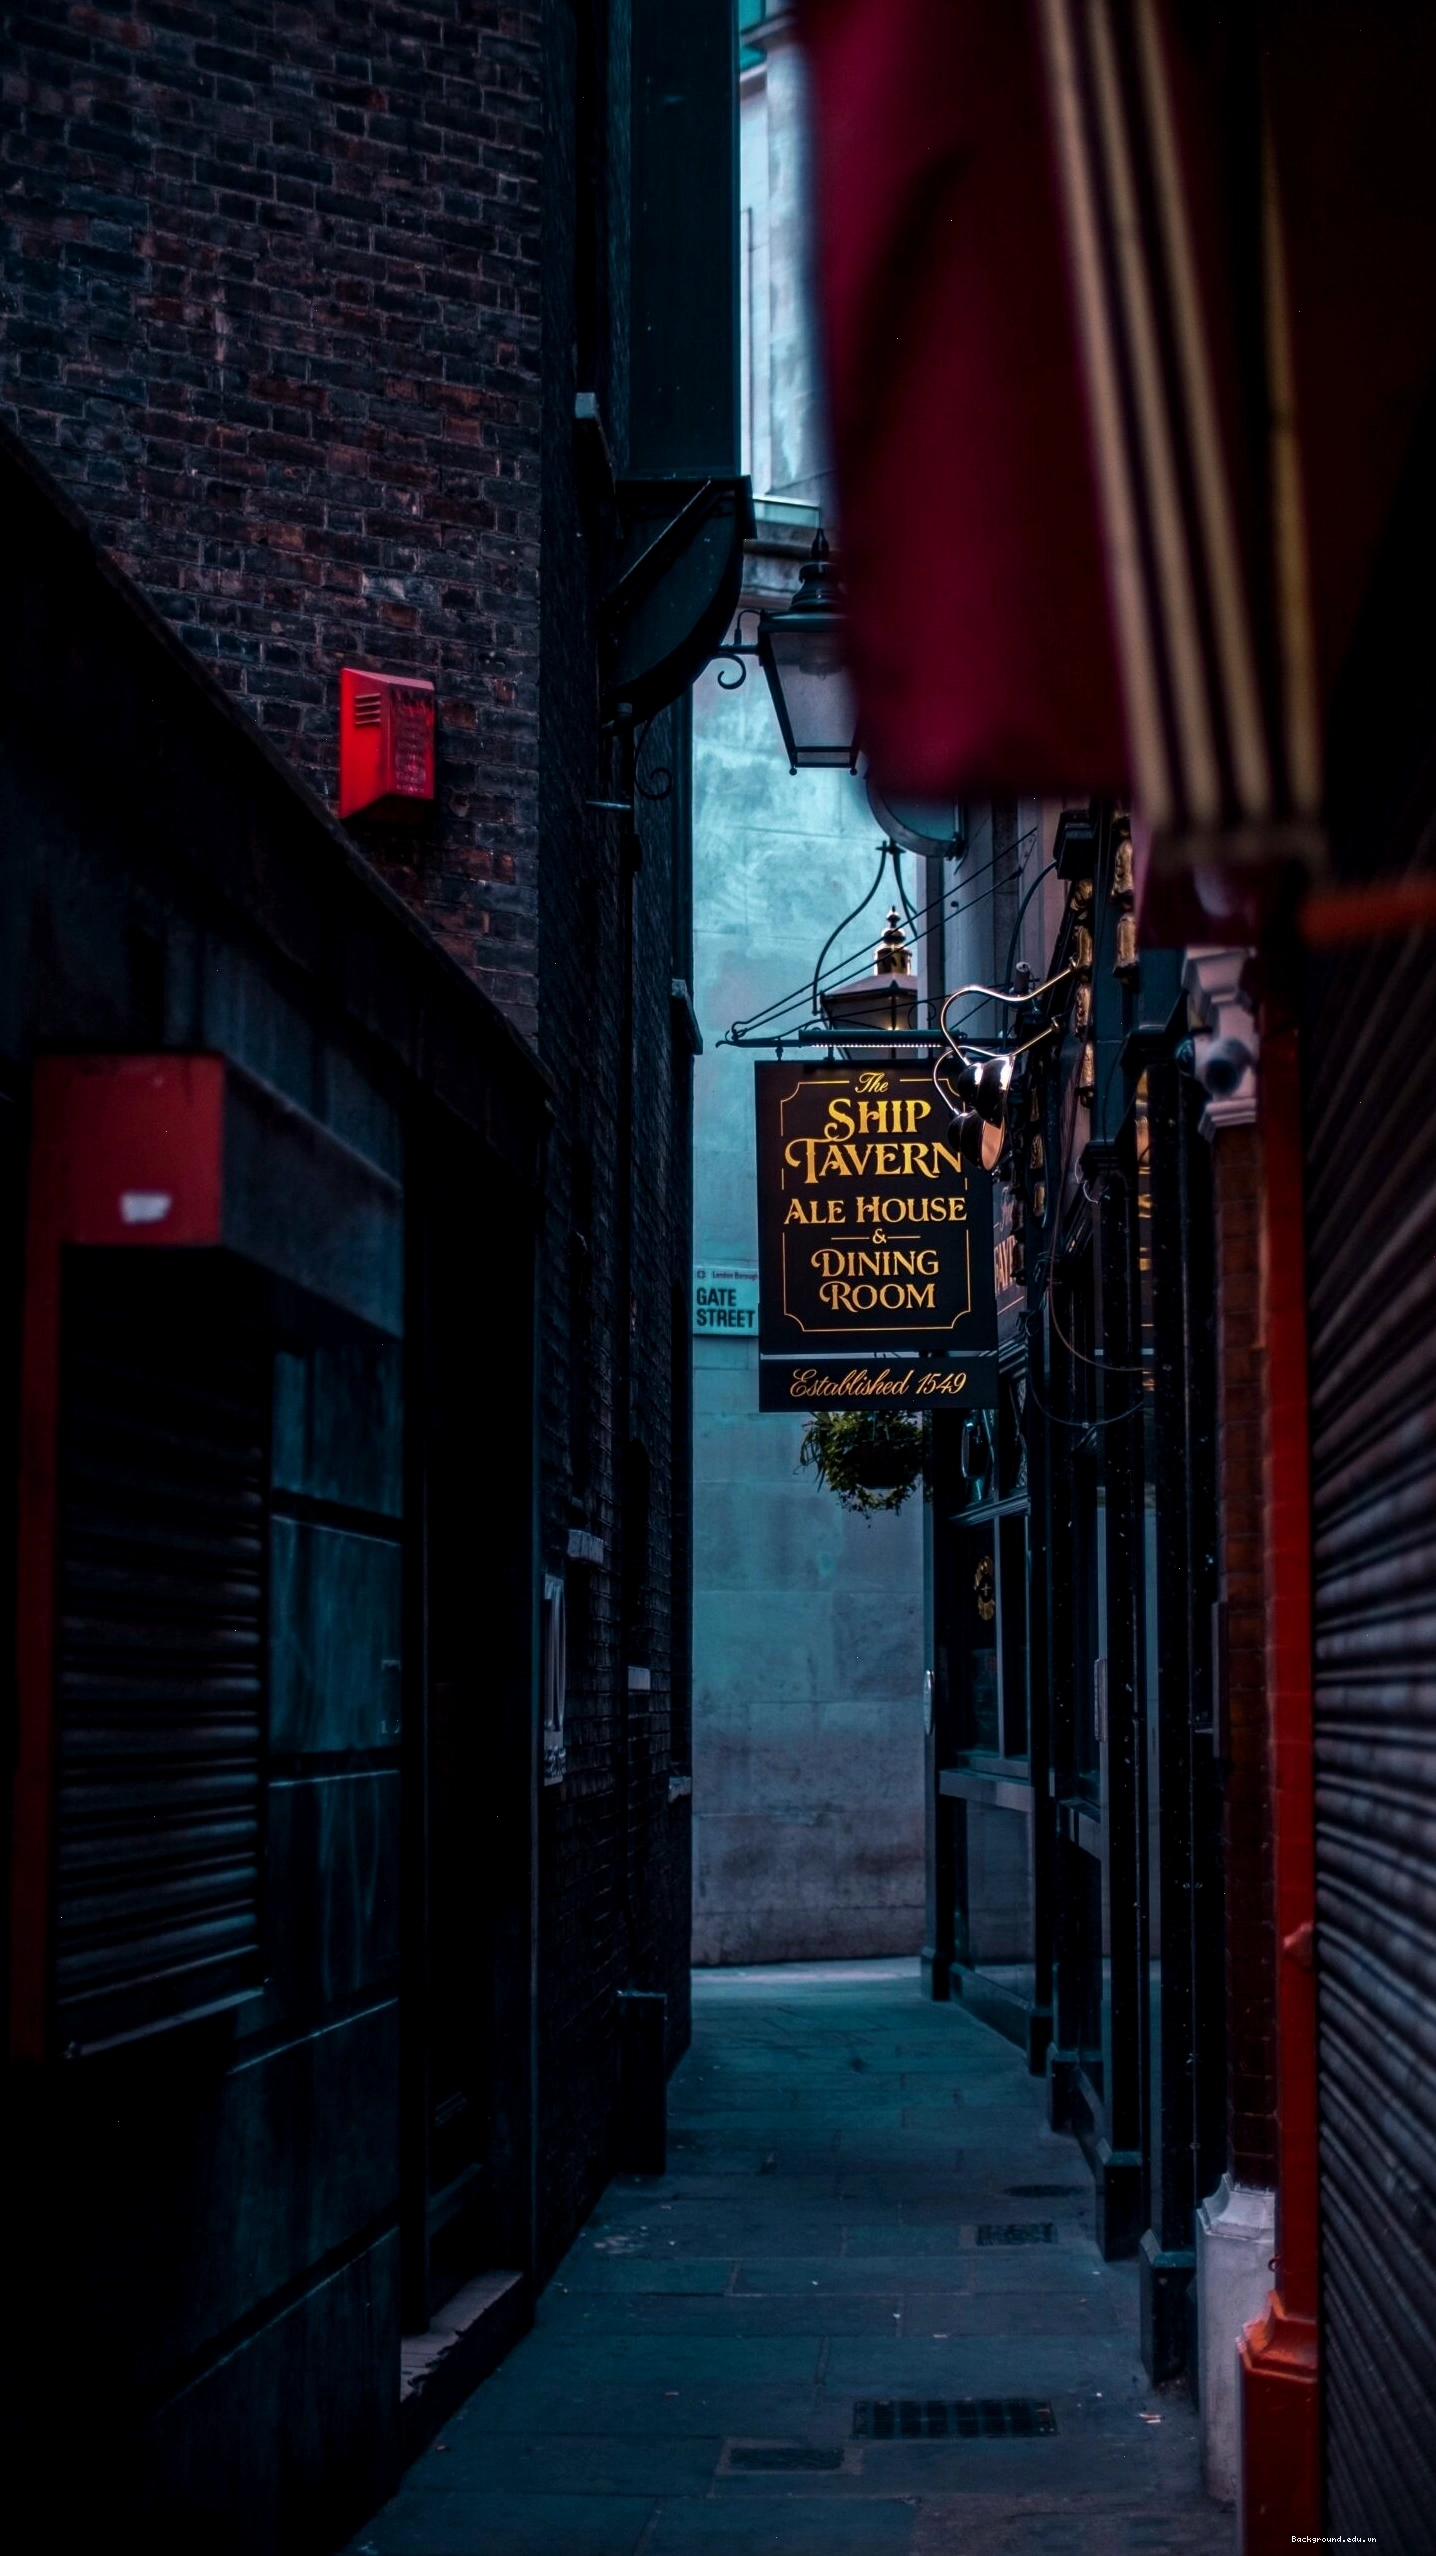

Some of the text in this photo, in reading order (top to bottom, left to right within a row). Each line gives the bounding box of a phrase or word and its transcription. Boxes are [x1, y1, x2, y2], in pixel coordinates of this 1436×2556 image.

[855, 1072, 888, 1093] The
[824, 1098, 932, 1142] SHIP
[785, 1138, 962, 1185] TAVERN
[784, 1196, 967, 1225] ALE HOUSE
[872, 1228, 887, 1244] &
[811, 1249, 939, 1277] DINING
[696, 1287, 737, 1307] GATE
[819, 1281, 936, 1312] ROOM
[696, 1308, 756, 1328] STREET
[790, 1369, 967, 1397] Established 1549
